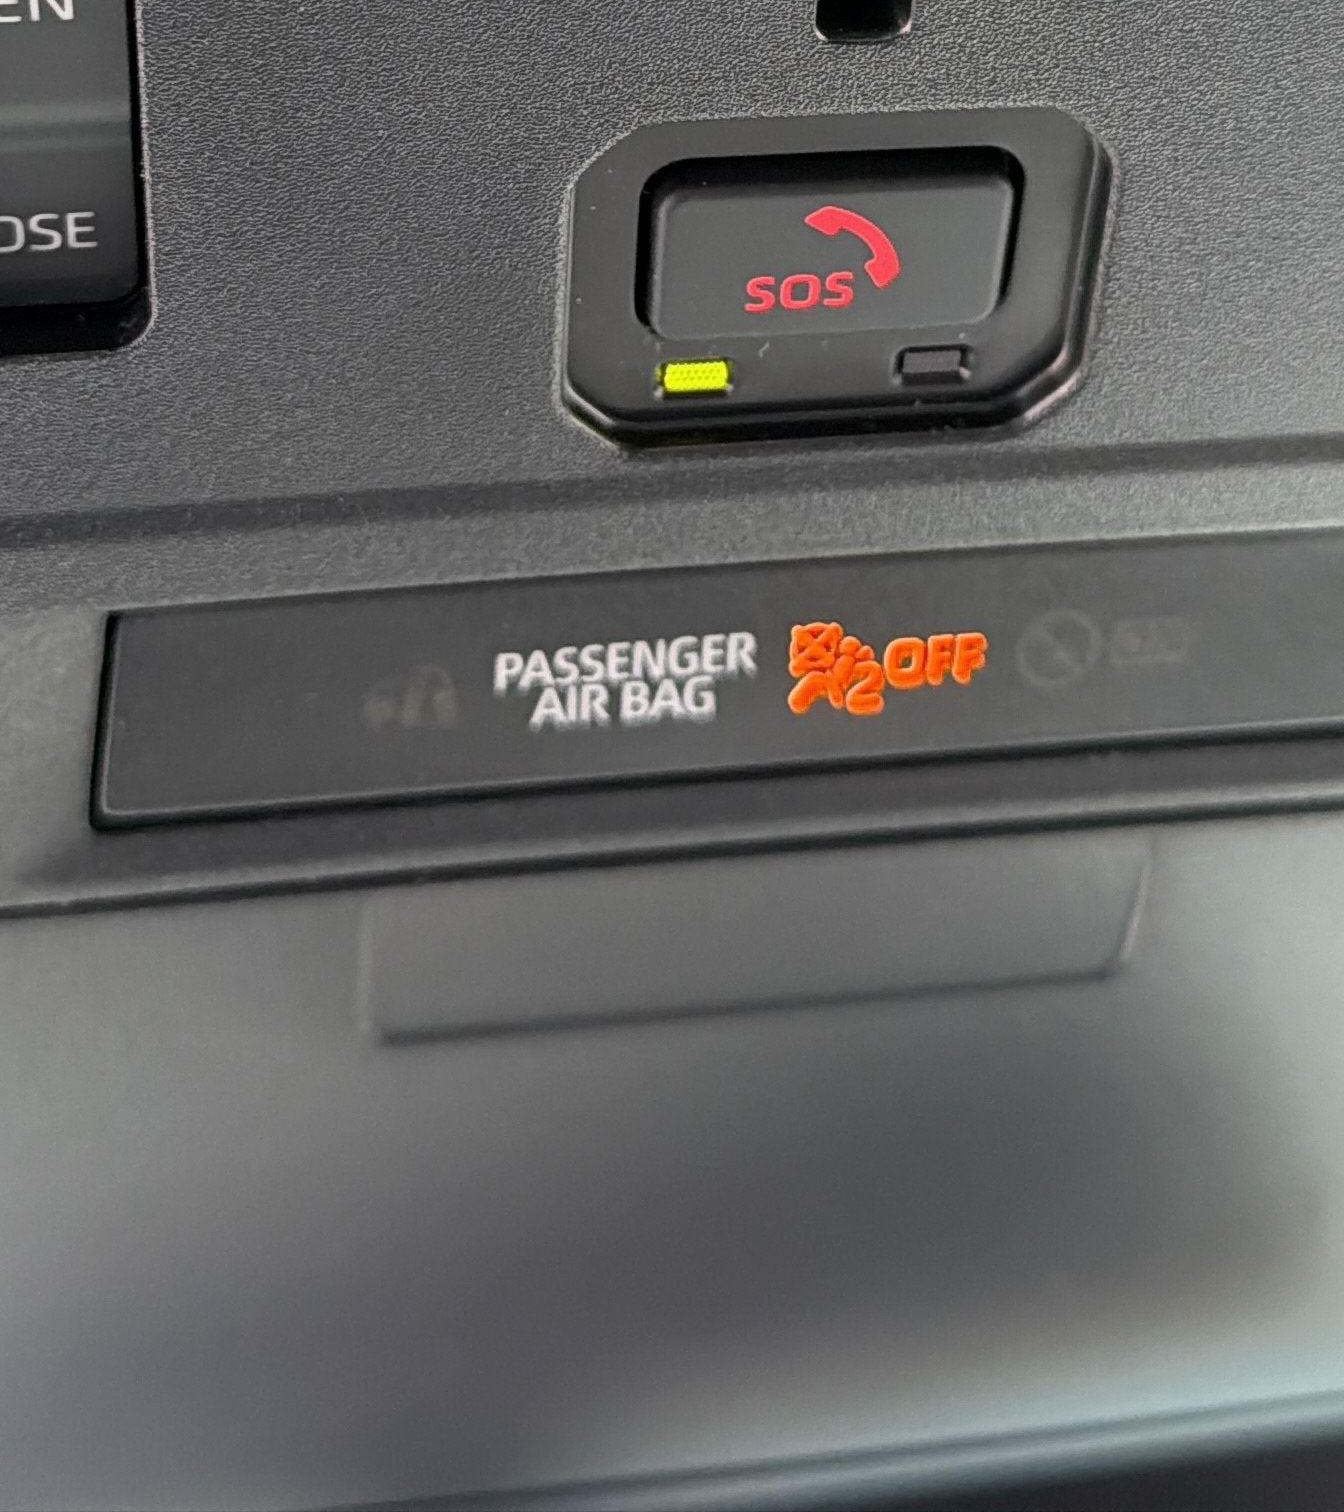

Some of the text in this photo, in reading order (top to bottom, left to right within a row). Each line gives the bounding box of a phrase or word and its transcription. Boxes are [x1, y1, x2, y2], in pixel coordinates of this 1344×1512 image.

[744, 271, 854, 312] SOS
[493, 631, 758, 697] PASSENGER
[883, 632, 988, 688] OFF
[529, 675, 716, 730] AIR BAG
